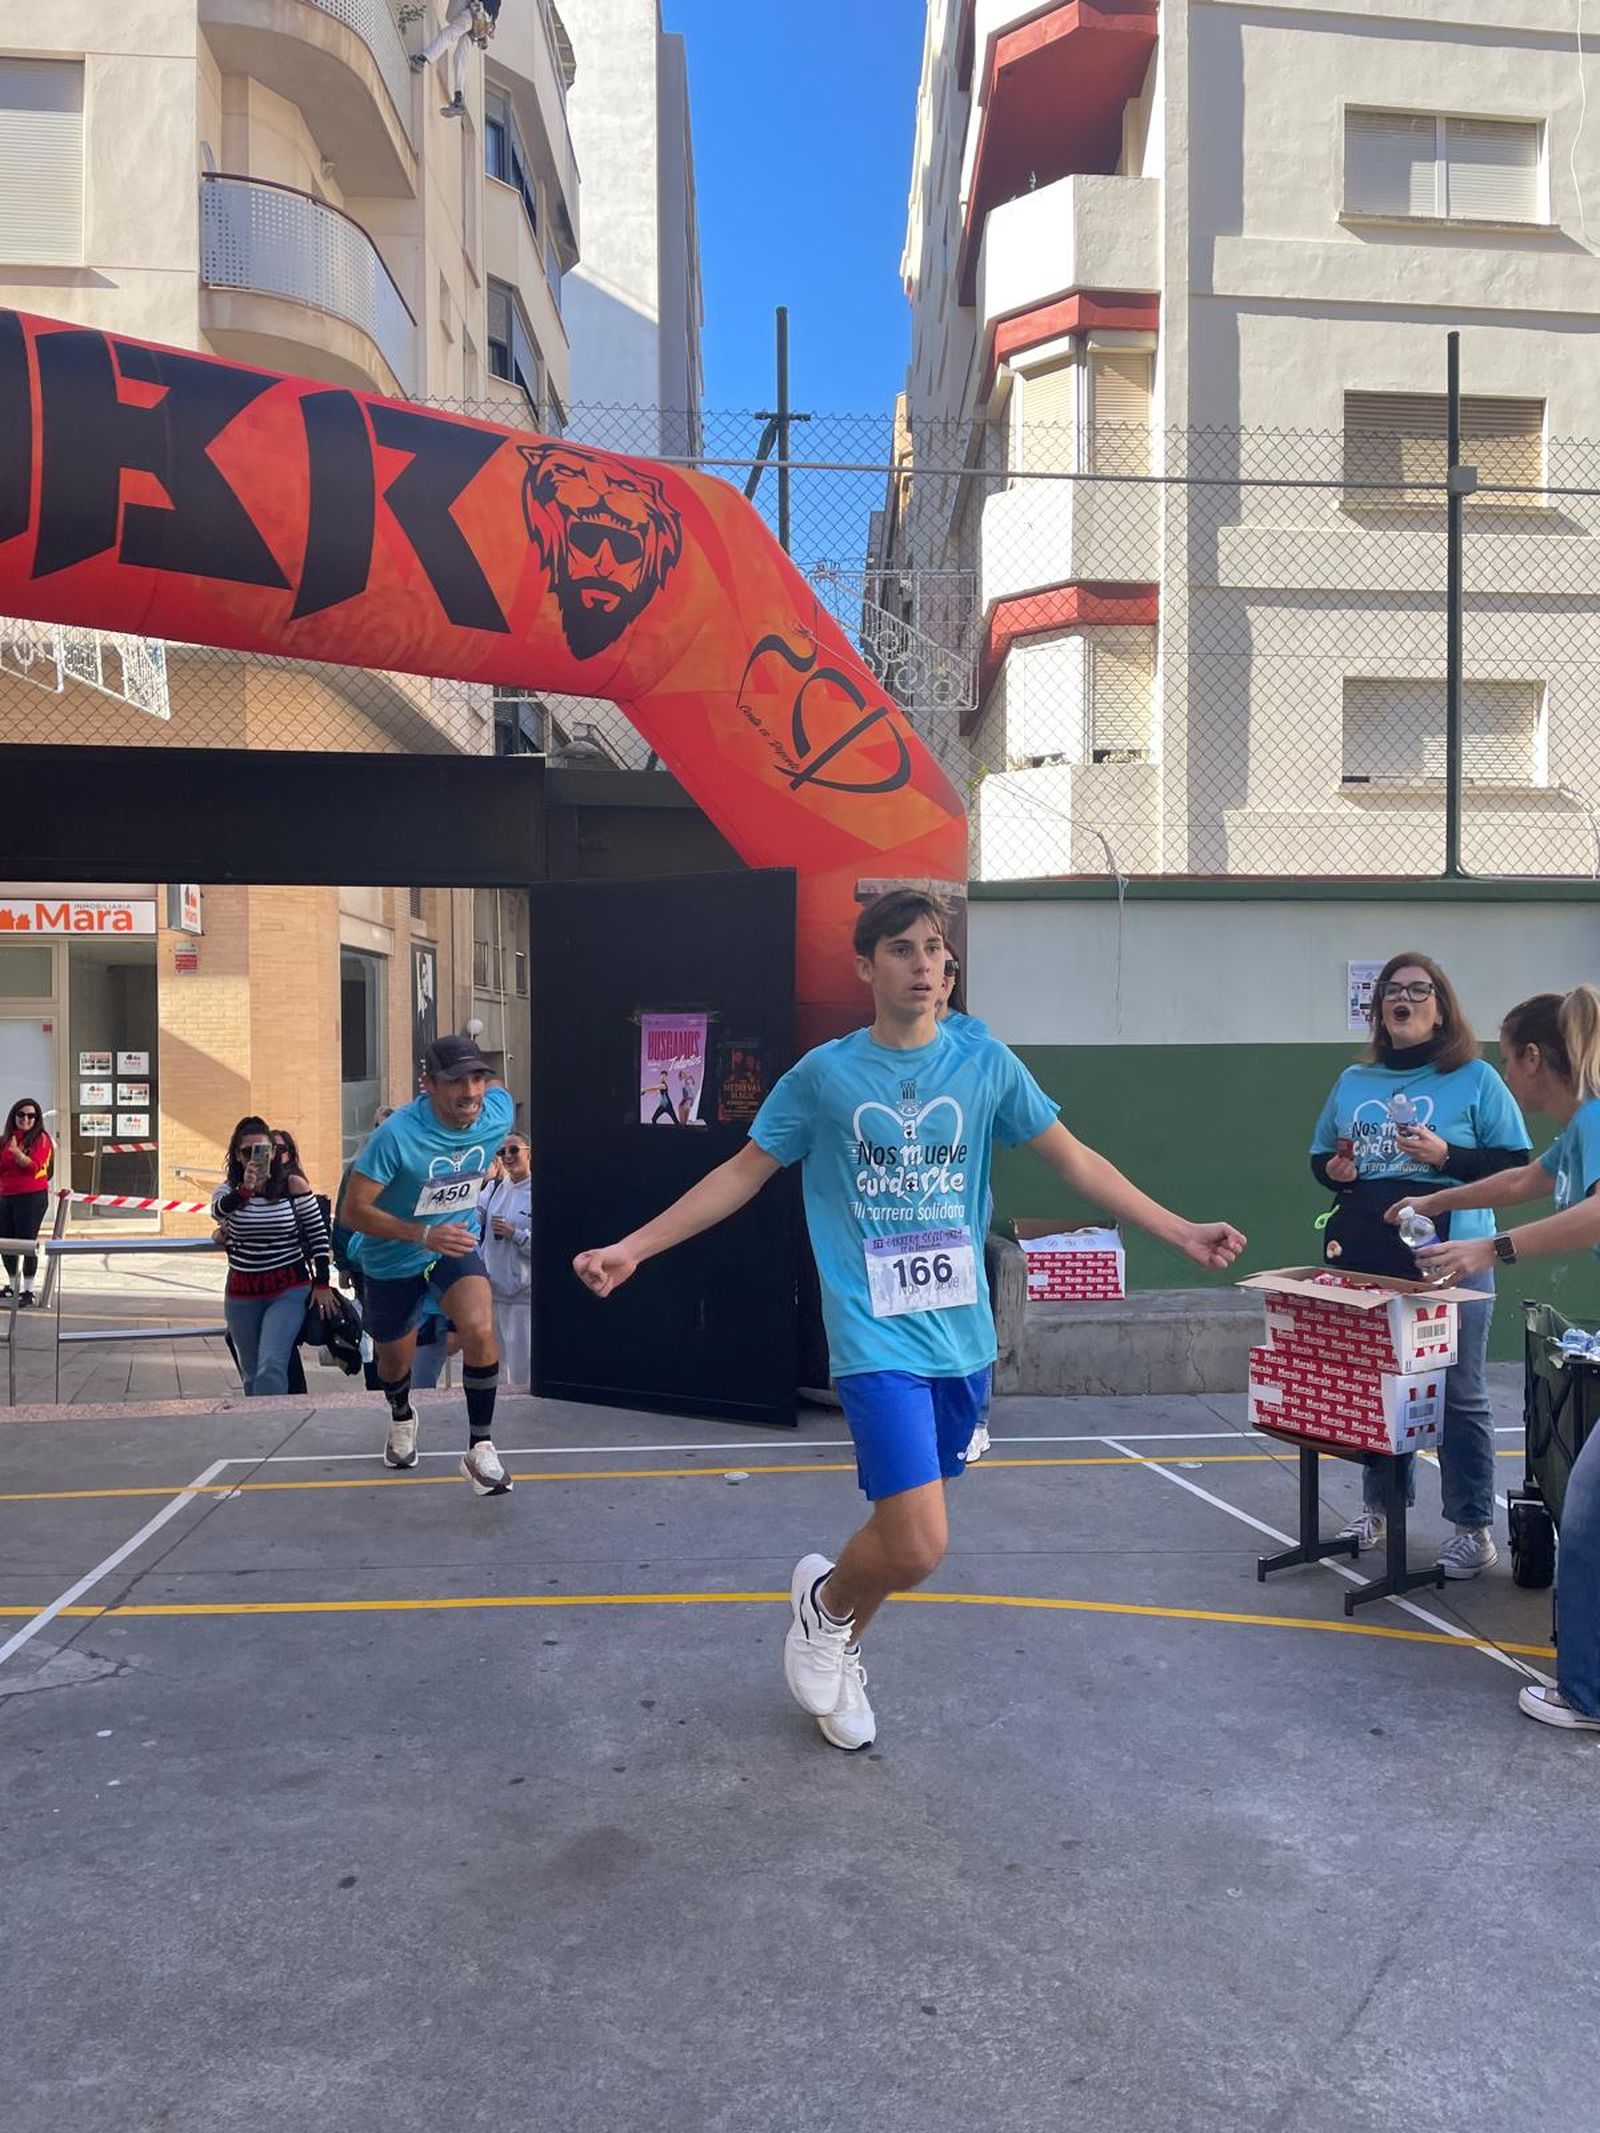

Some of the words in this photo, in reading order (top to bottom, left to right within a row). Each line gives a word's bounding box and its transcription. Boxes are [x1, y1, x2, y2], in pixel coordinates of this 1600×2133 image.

[35, 903, 134, 932] Mara
[858, 1141, 898, 1165] Nos
[900, 1144, 968, 1166] mueve
[432, 1183, 471, 1202] 450
[856, 1166, 966, 1198] cuidarte
[893, 1253, 953, 1289] 166
